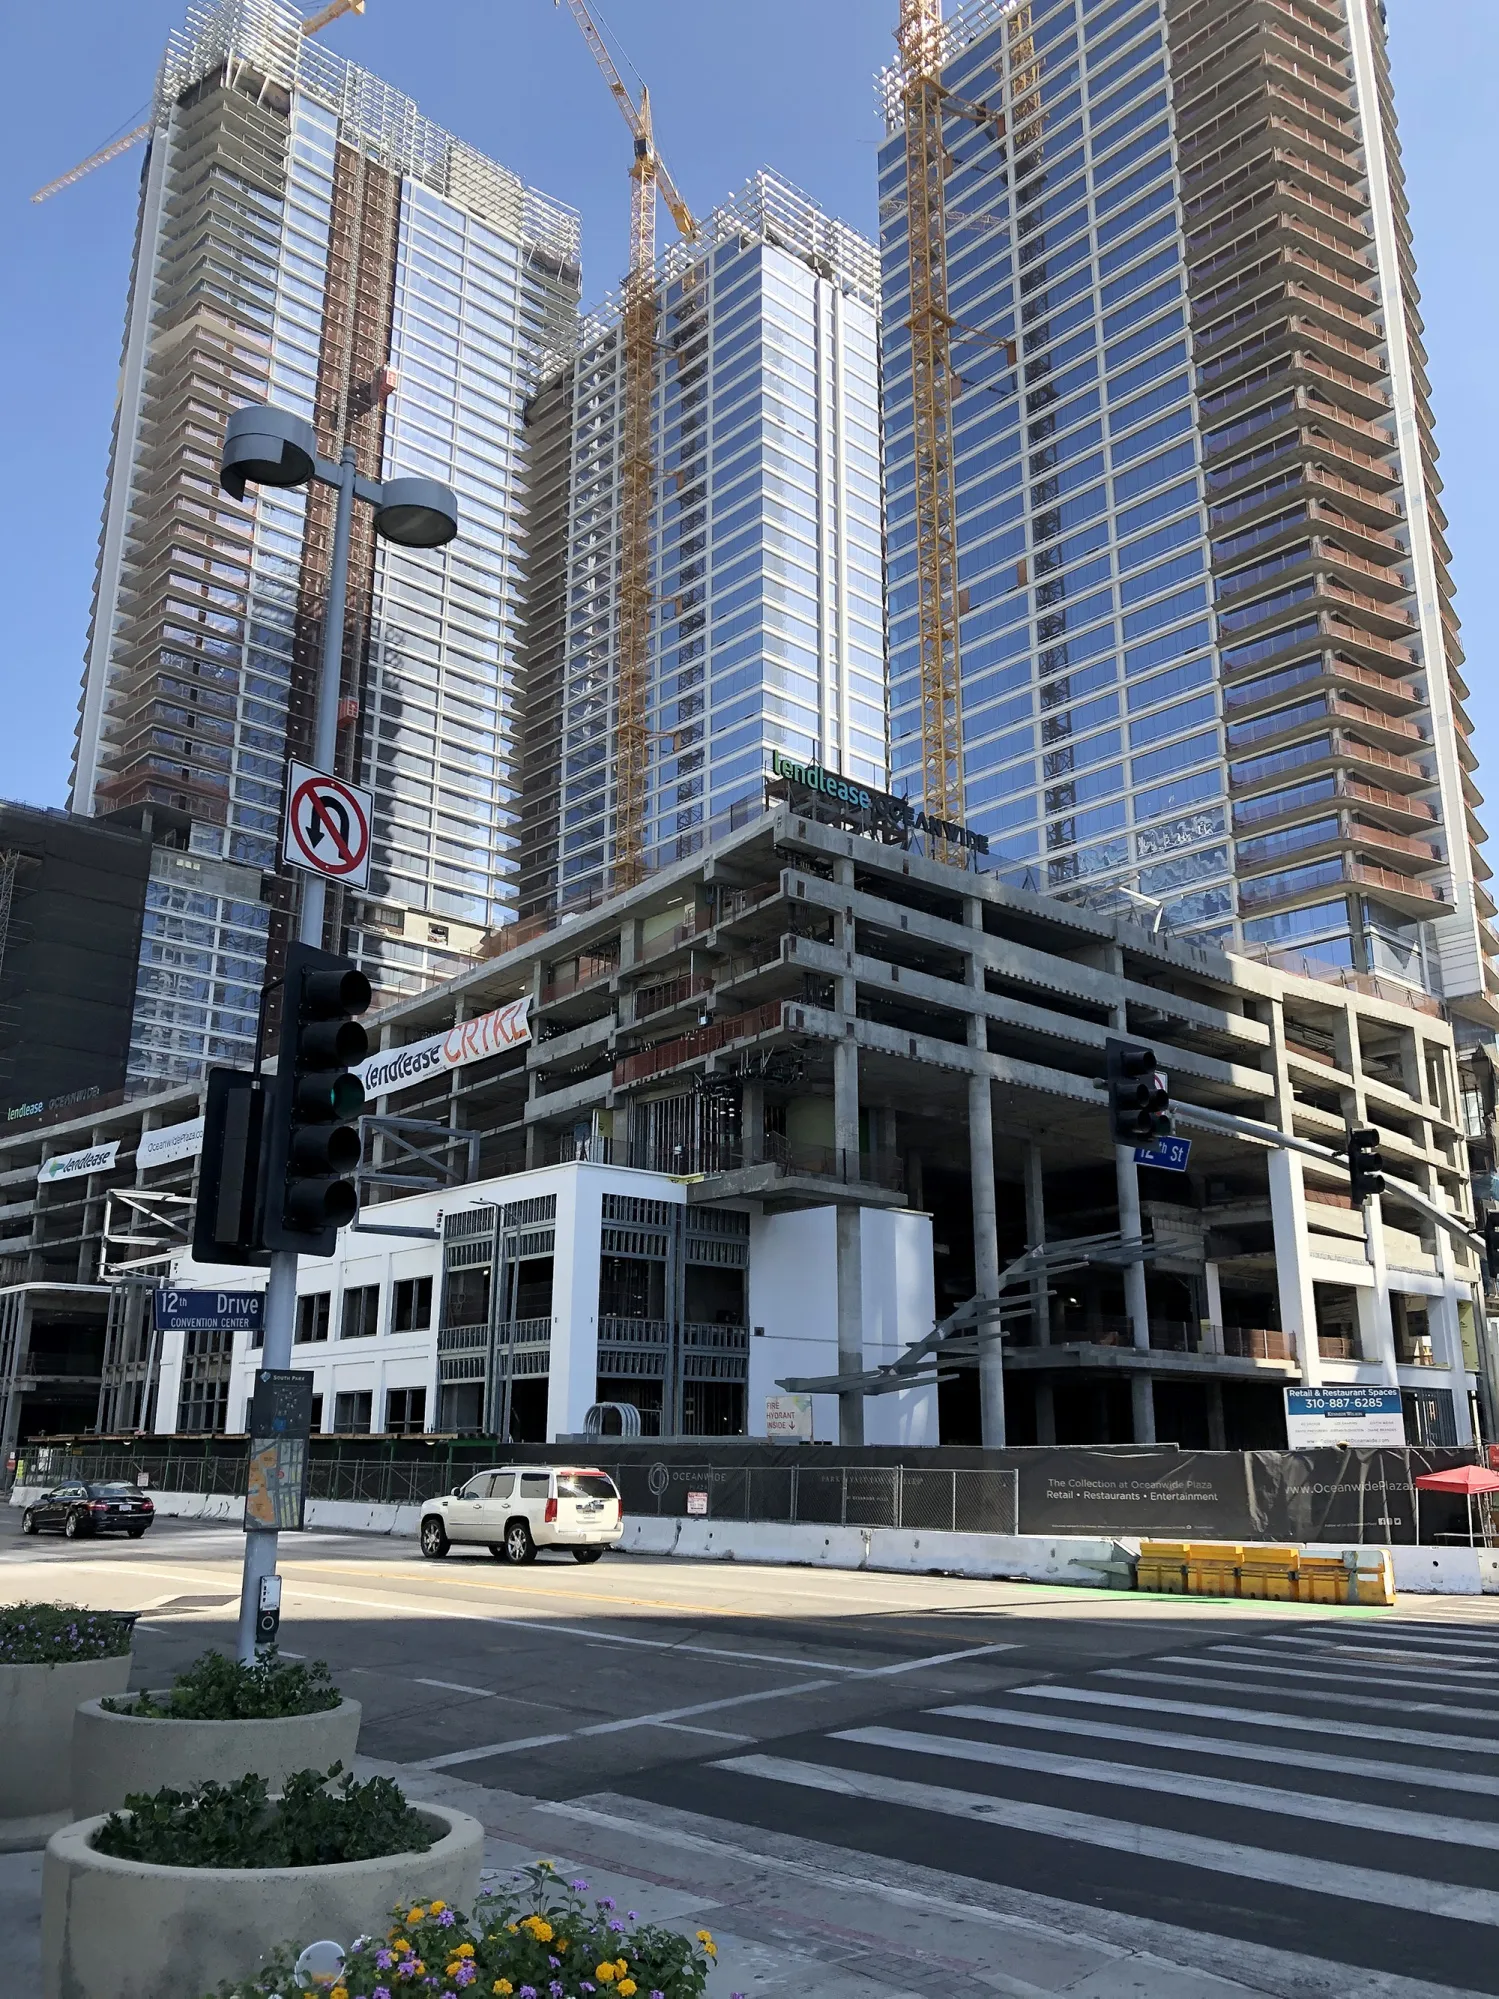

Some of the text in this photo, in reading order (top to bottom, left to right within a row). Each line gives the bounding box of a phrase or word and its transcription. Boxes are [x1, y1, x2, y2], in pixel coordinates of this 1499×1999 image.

[773, 749, 990, 855] lendlease OCEANWIDE
[443, 1002, 527, 1063] CRTKL
[365, 1044, 442, 1091] lendlease
[7, 1101, 44, 1121] lendlease
[147, 1129, 204, 1153] OceanwidePlaza.co
[1170, 1145, 1184, 1163] St
[62, 1149, 111, 1174] lendlease
[161, 1292, 259, 1314] 12th Drive
[170, 1317, 250, 1328] CONVENTION CENTER
[1289, 1388, 1398, 1398] Retail & Restaurant Spaces
[766, 1401, 780, 1410] FIRE
[1305, 1397, 1383, 1409] 310-887-6285
[766, 1411, 795, 1419] HYDRANT
[767, 1421, 787, 1429] INSIDE
[672, 1471, 727, 1482] OCEANWIDE
[1048, 1478, 1212, 1491] The Collection at Oceanwide Plaza
[1046, 1490, 1219, 1502] Retail Restaurants Entertainment
